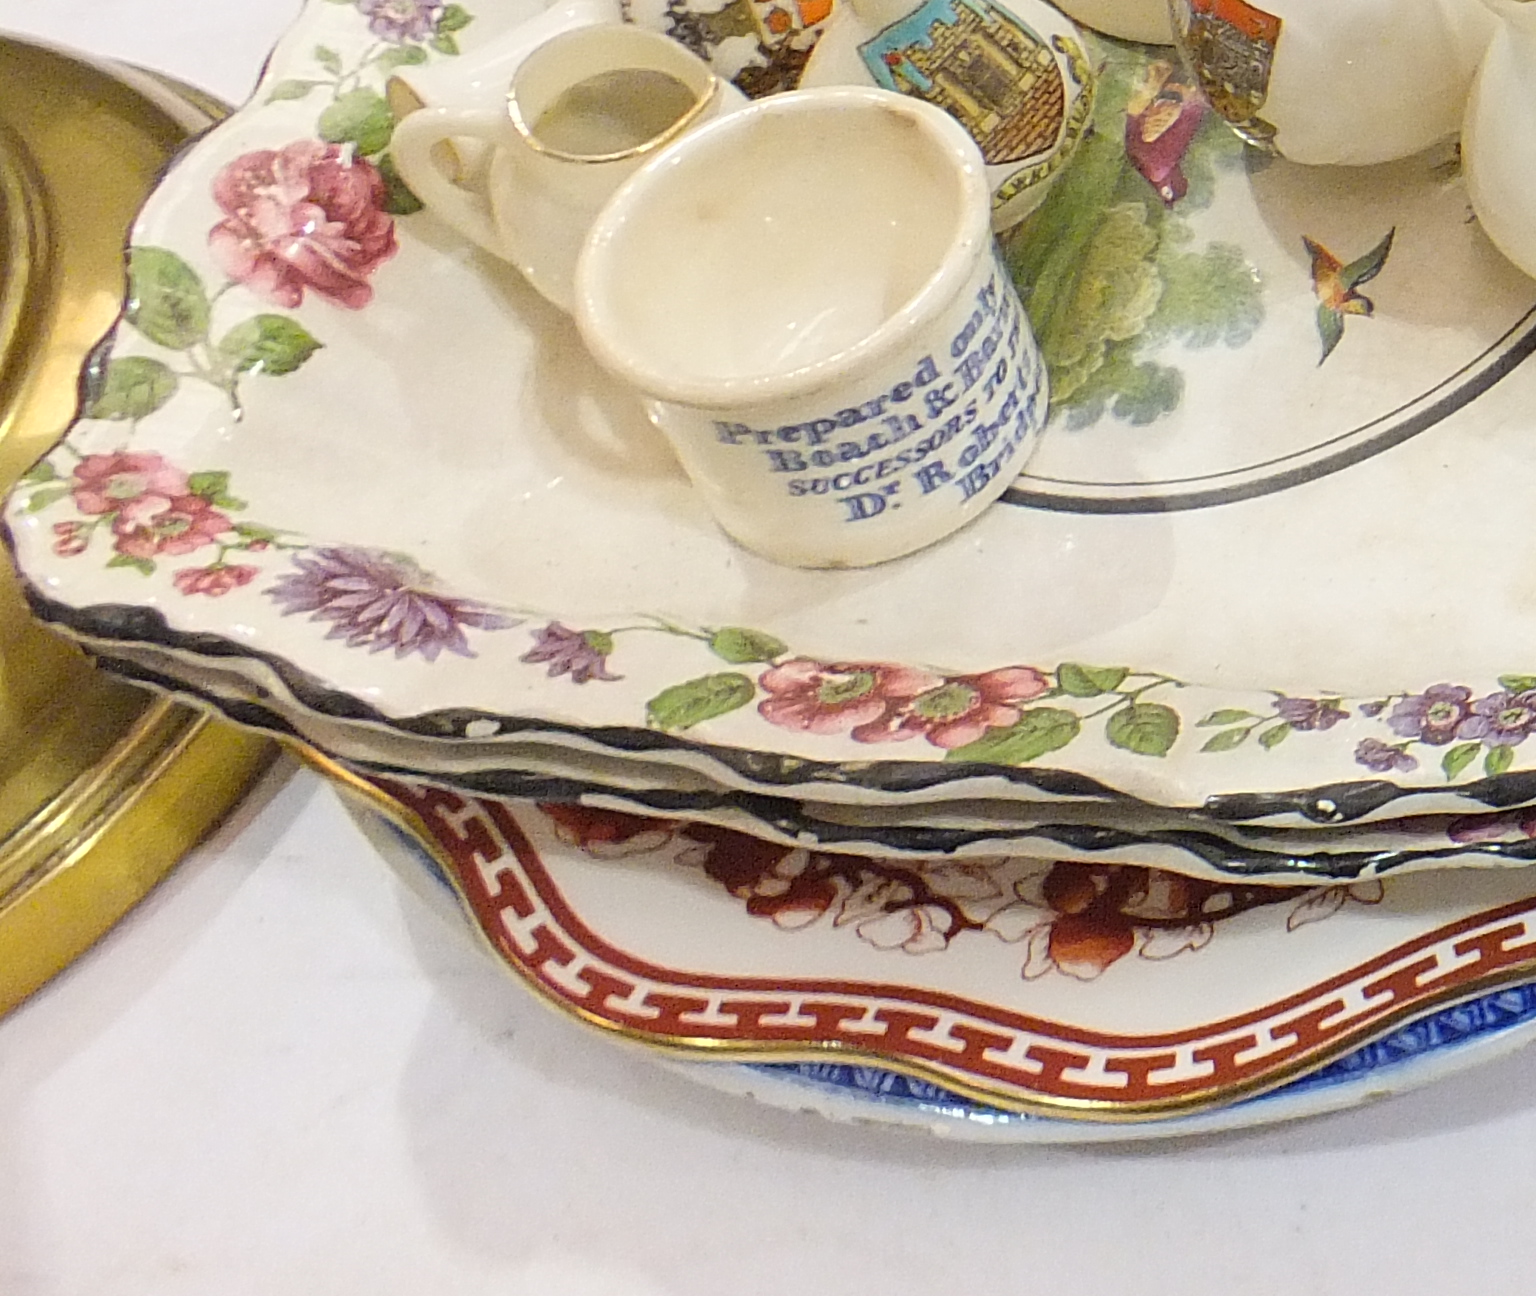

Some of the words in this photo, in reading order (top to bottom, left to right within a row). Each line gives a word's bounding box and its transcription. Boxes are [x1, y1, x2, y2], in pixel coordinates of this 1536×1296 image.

[712, 354, 942, 446] Prepared
[924, 381, 960, 420] &
[788, 399, 978, 496] SUCCESSORS
